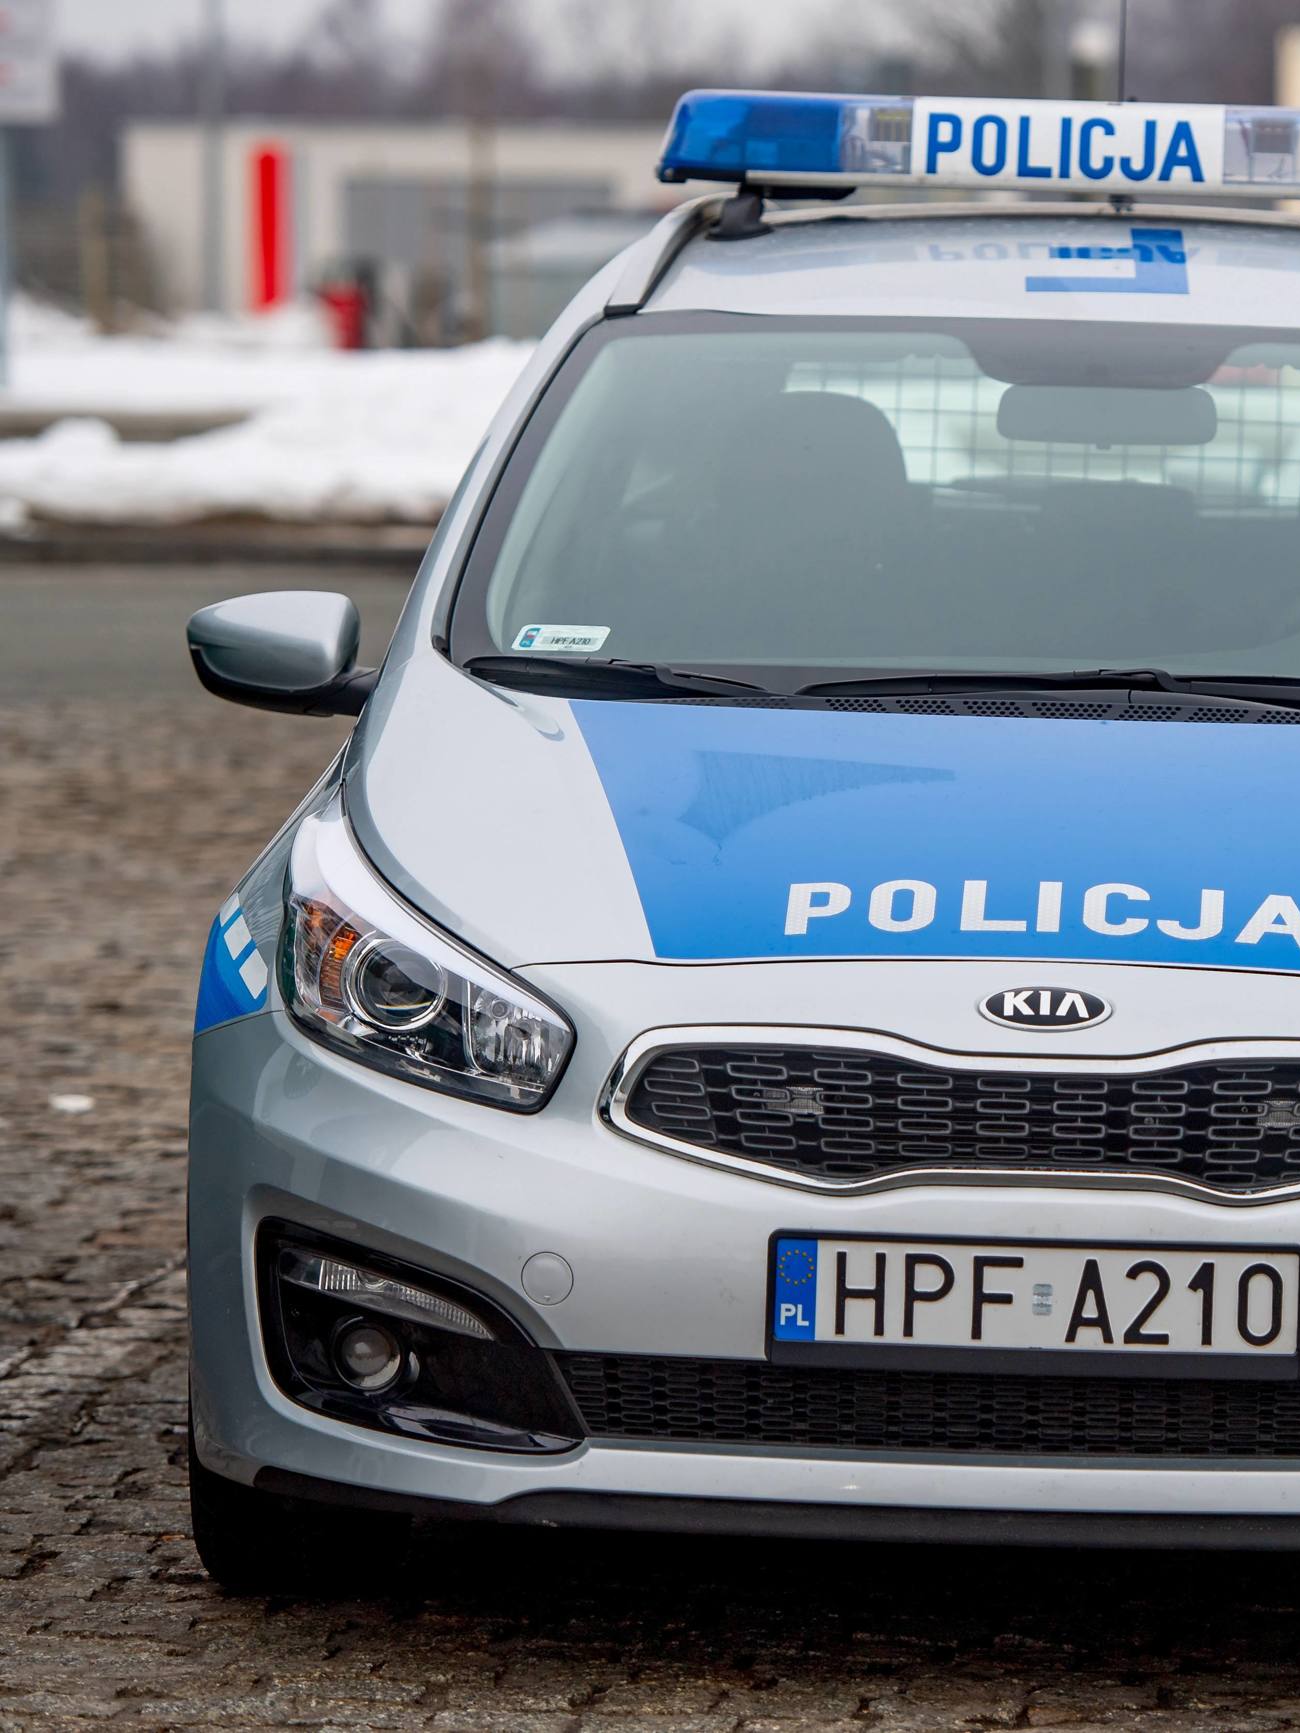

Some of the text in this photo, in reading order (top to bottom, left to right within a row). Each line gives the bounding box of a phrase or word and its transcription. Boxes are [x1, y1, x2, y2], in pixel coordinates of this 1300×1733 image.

[926, 111, 1205, 183] POLICJA
[1001, 990, 1090, 1019] KIA
[780, 1303, 810, 1327] PL
[834, 1250, 1284, 1347] HPF A210
